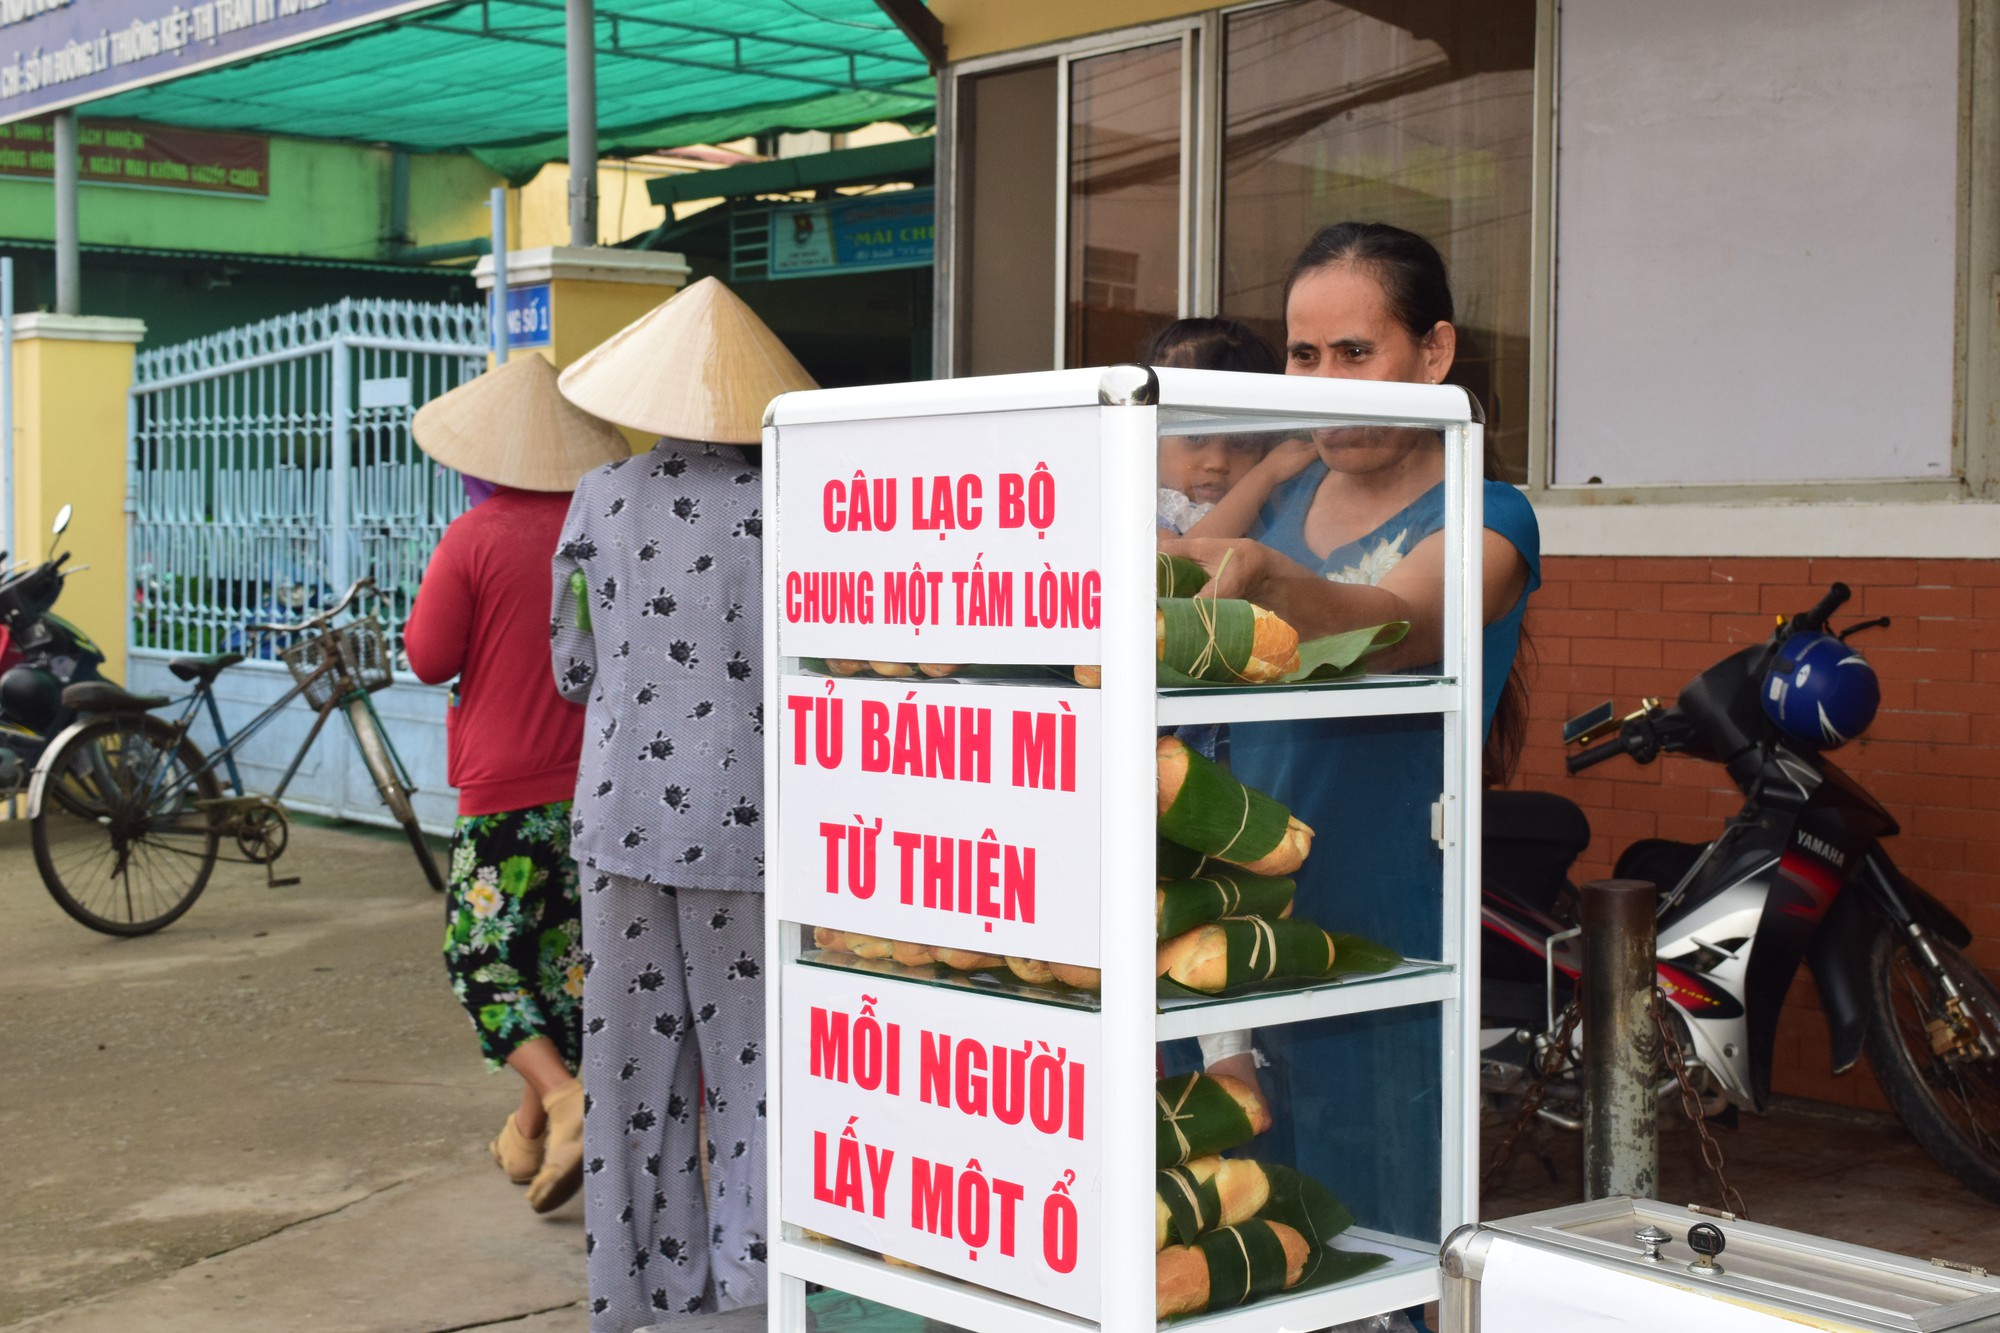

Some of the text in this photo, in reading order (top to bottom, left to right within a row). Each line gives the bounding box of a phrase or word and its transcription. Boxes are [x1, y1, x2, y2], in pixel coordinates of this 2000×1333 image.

[94, 28, 109, 72] LÝ
[522, 297, 539, 333] SỐ
[540, 306, 548, 331] 1
[823, 461, 1055, 541] CÂU LẠC BỘ
[786, 552, 1101, 636] CHUNG MỘT TẤM LÒNG
[788, 679, 1076, 792] TỦ BÁNH MÌ
[820, 813, 1036, 933] TỪ THIỆN
[1797, 829, 1845, 868] YAMAHA
[810, 993, 1085, 1141] MỖI NGƯỜI
[814, 1115, 1078, 1274] LẤY MỘT Ổ
